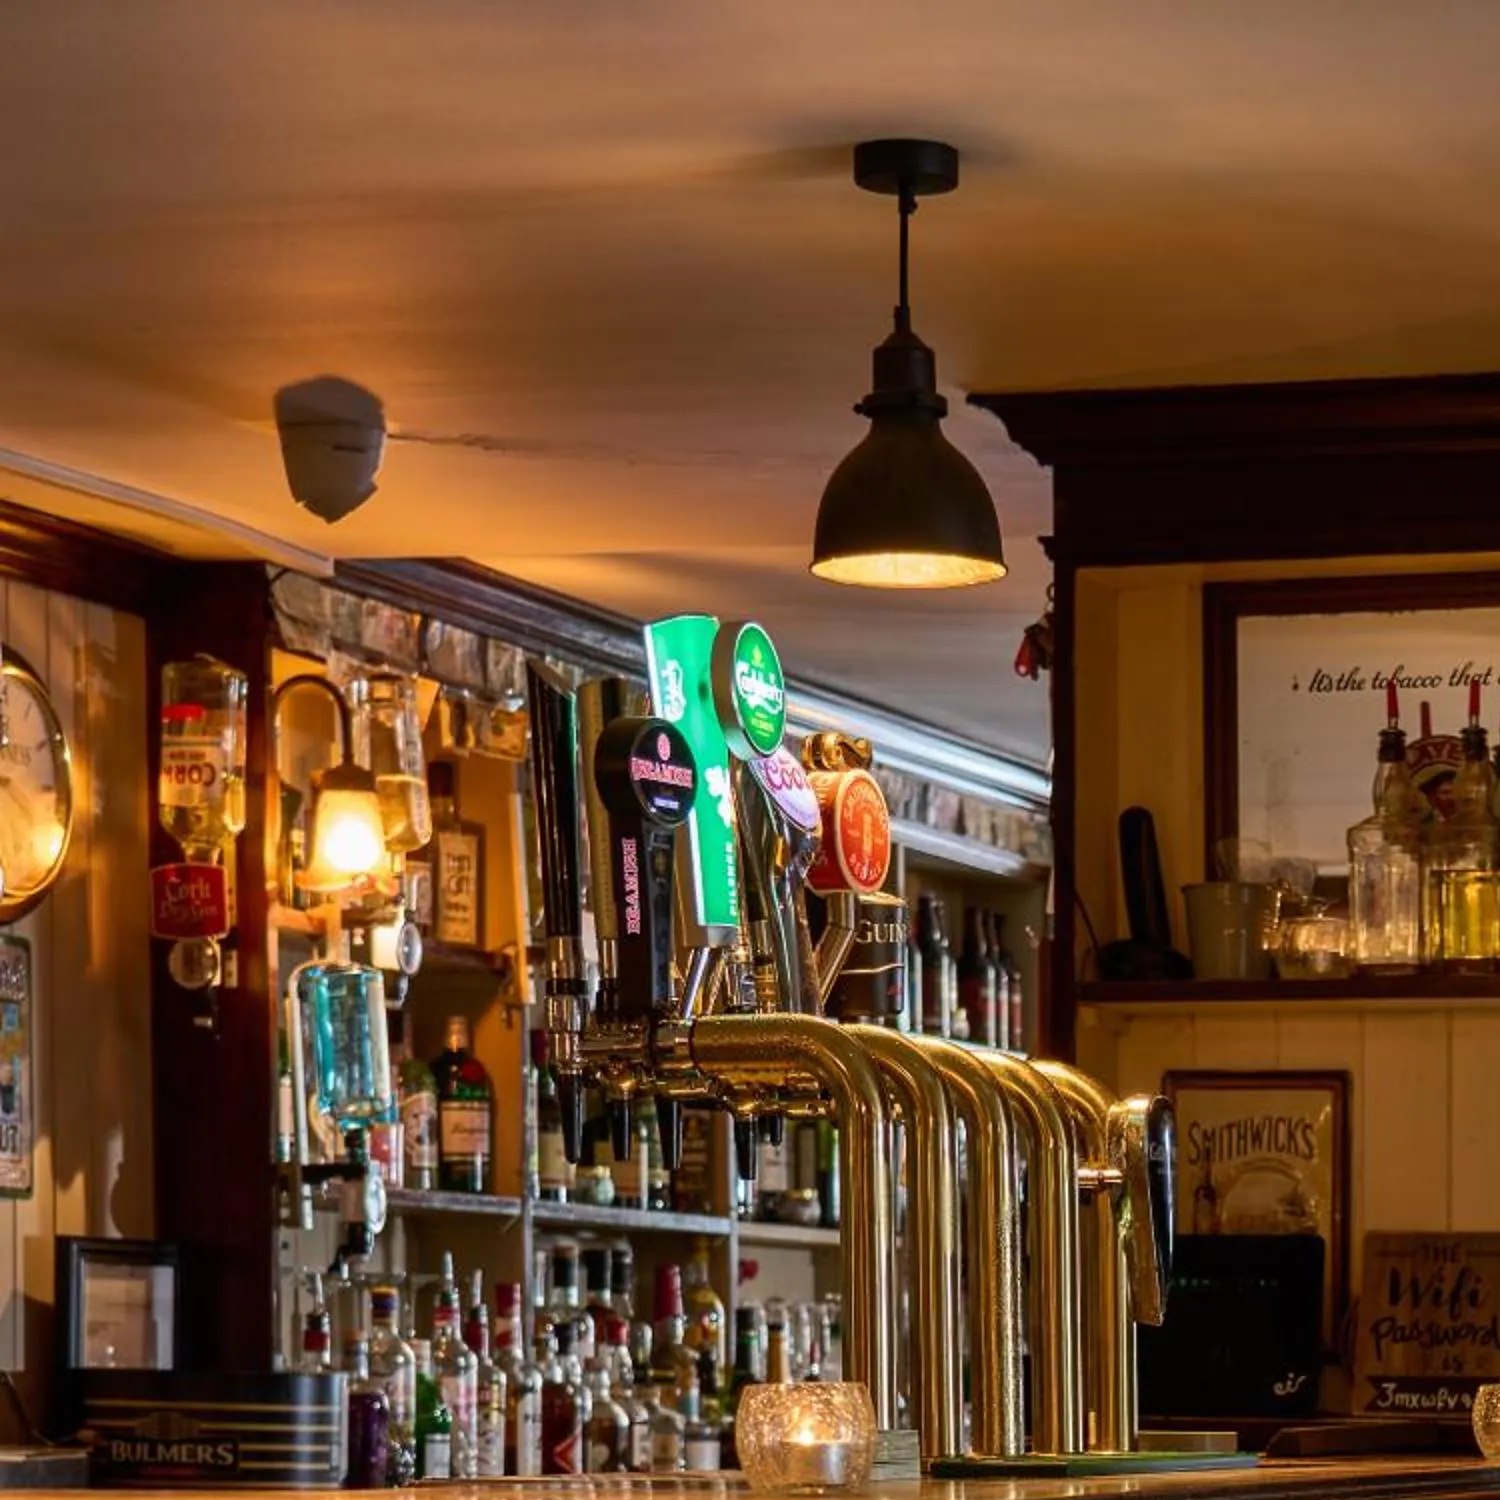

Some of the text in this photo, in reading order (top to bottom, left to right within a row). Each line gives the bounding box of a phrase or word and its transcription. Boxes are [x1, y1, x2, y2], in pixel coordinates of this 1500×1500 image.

[1336, 667, 1365, 691] the
[1371, 664, 1442, 689] tobacco
[1449, 661, 1491, 687] that
[766, 760, 810, 790] Coo
[622, 837, 641, 935] BEAMISH
[855, 919, 907, 944] GUIN
[1420, 1243, 1463, 1263] THE
[1389, 1266, 1490, 1321] Wifi
[1272, 1372, 1307, 1396] eir
[111, 1439, 235, 1467] BULMERS
